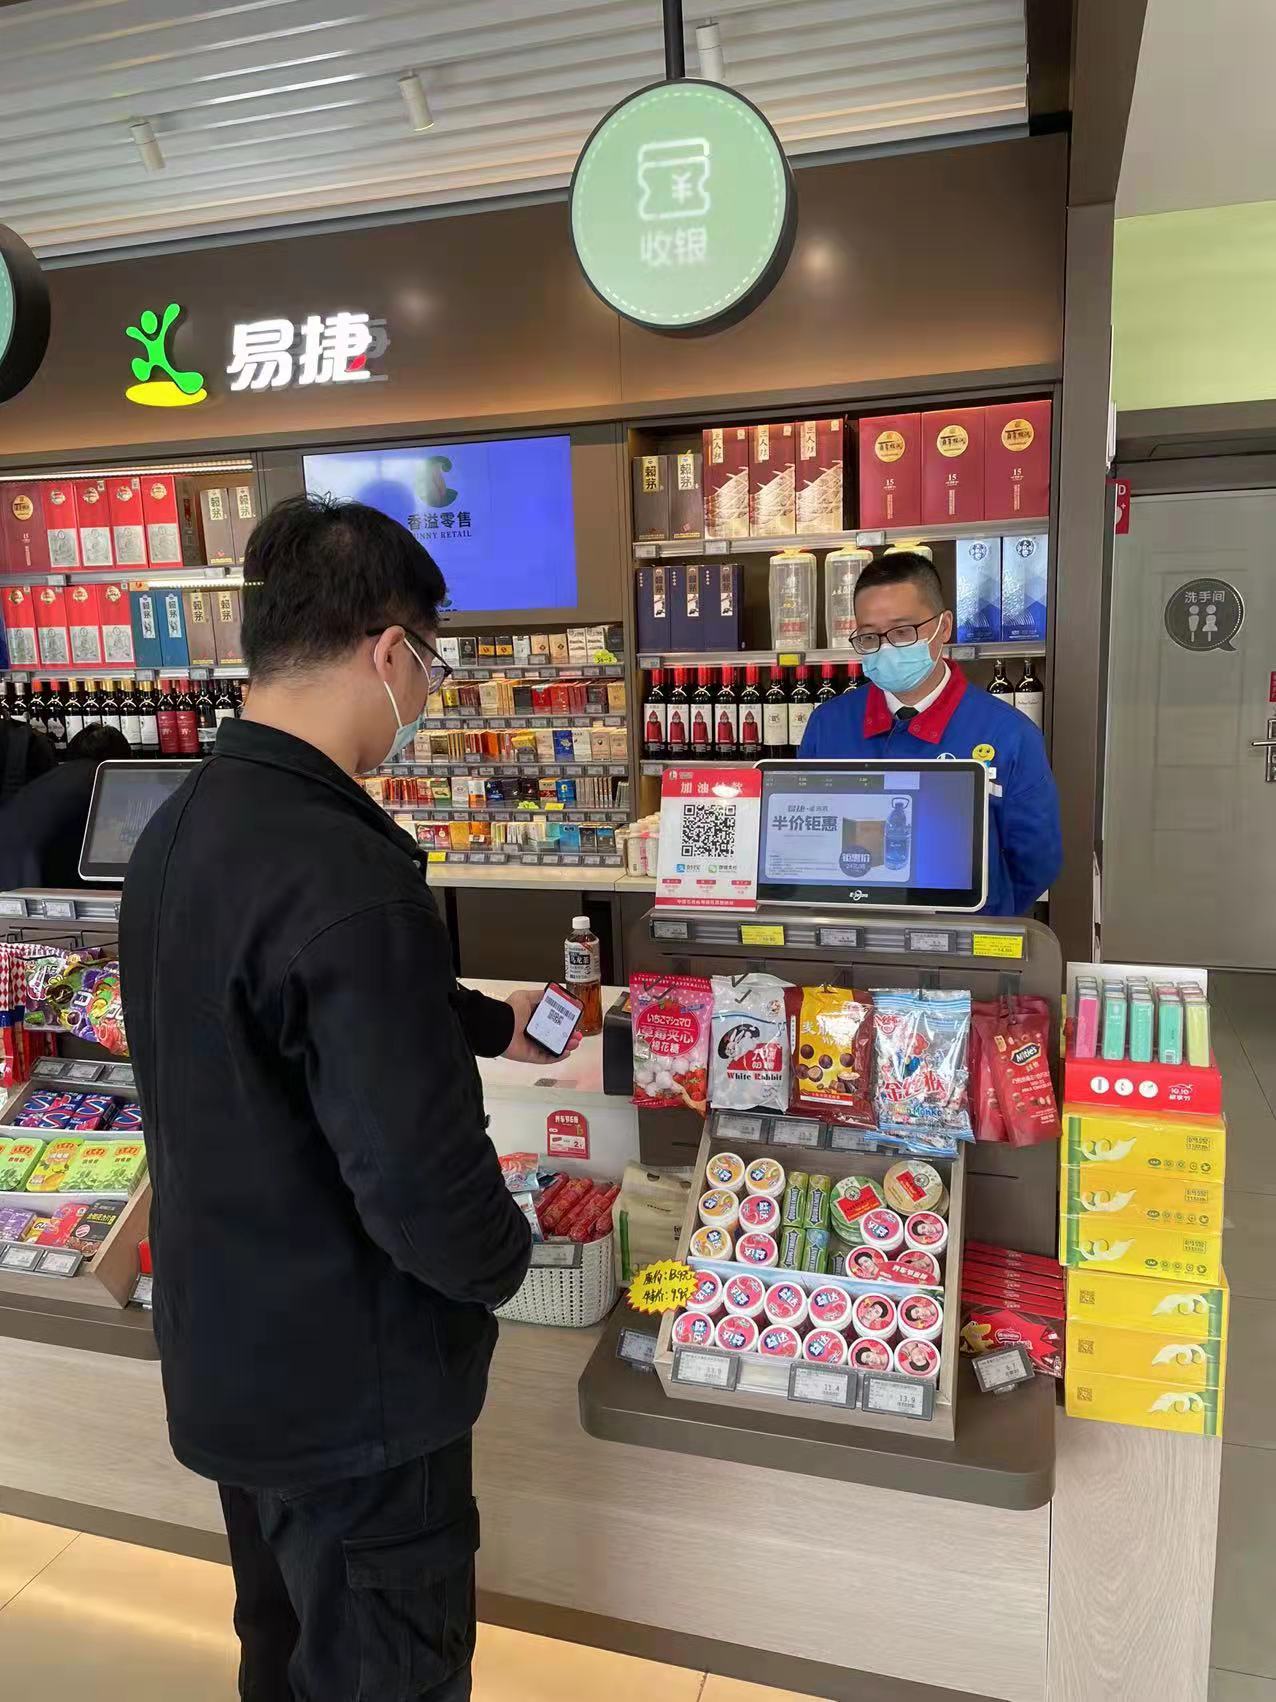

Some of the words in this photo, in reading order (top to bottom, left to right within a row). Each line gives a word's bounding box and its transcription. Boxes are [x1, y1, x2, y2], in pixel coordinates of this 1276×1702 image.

[641, 227, 707, 266] 收银
[227, 312, 373, 391] 易捷
[948, 473, 957, 481] 15
[1013, 468, 1022, 476] 15
[886, 478, 895, 486] 15
[408, 511, 472, 530] 香溢零售
[413, 531, 437, 540] UNNY
[440, 530, 472, 539] RETAIL
[1184, 590, 1226, 603] 洗手间
[772, 815, 839, 832] 半价钜惠
[727, 1072, 751, 1081] White
[754, 1072, 783, 1081] Rabbit
